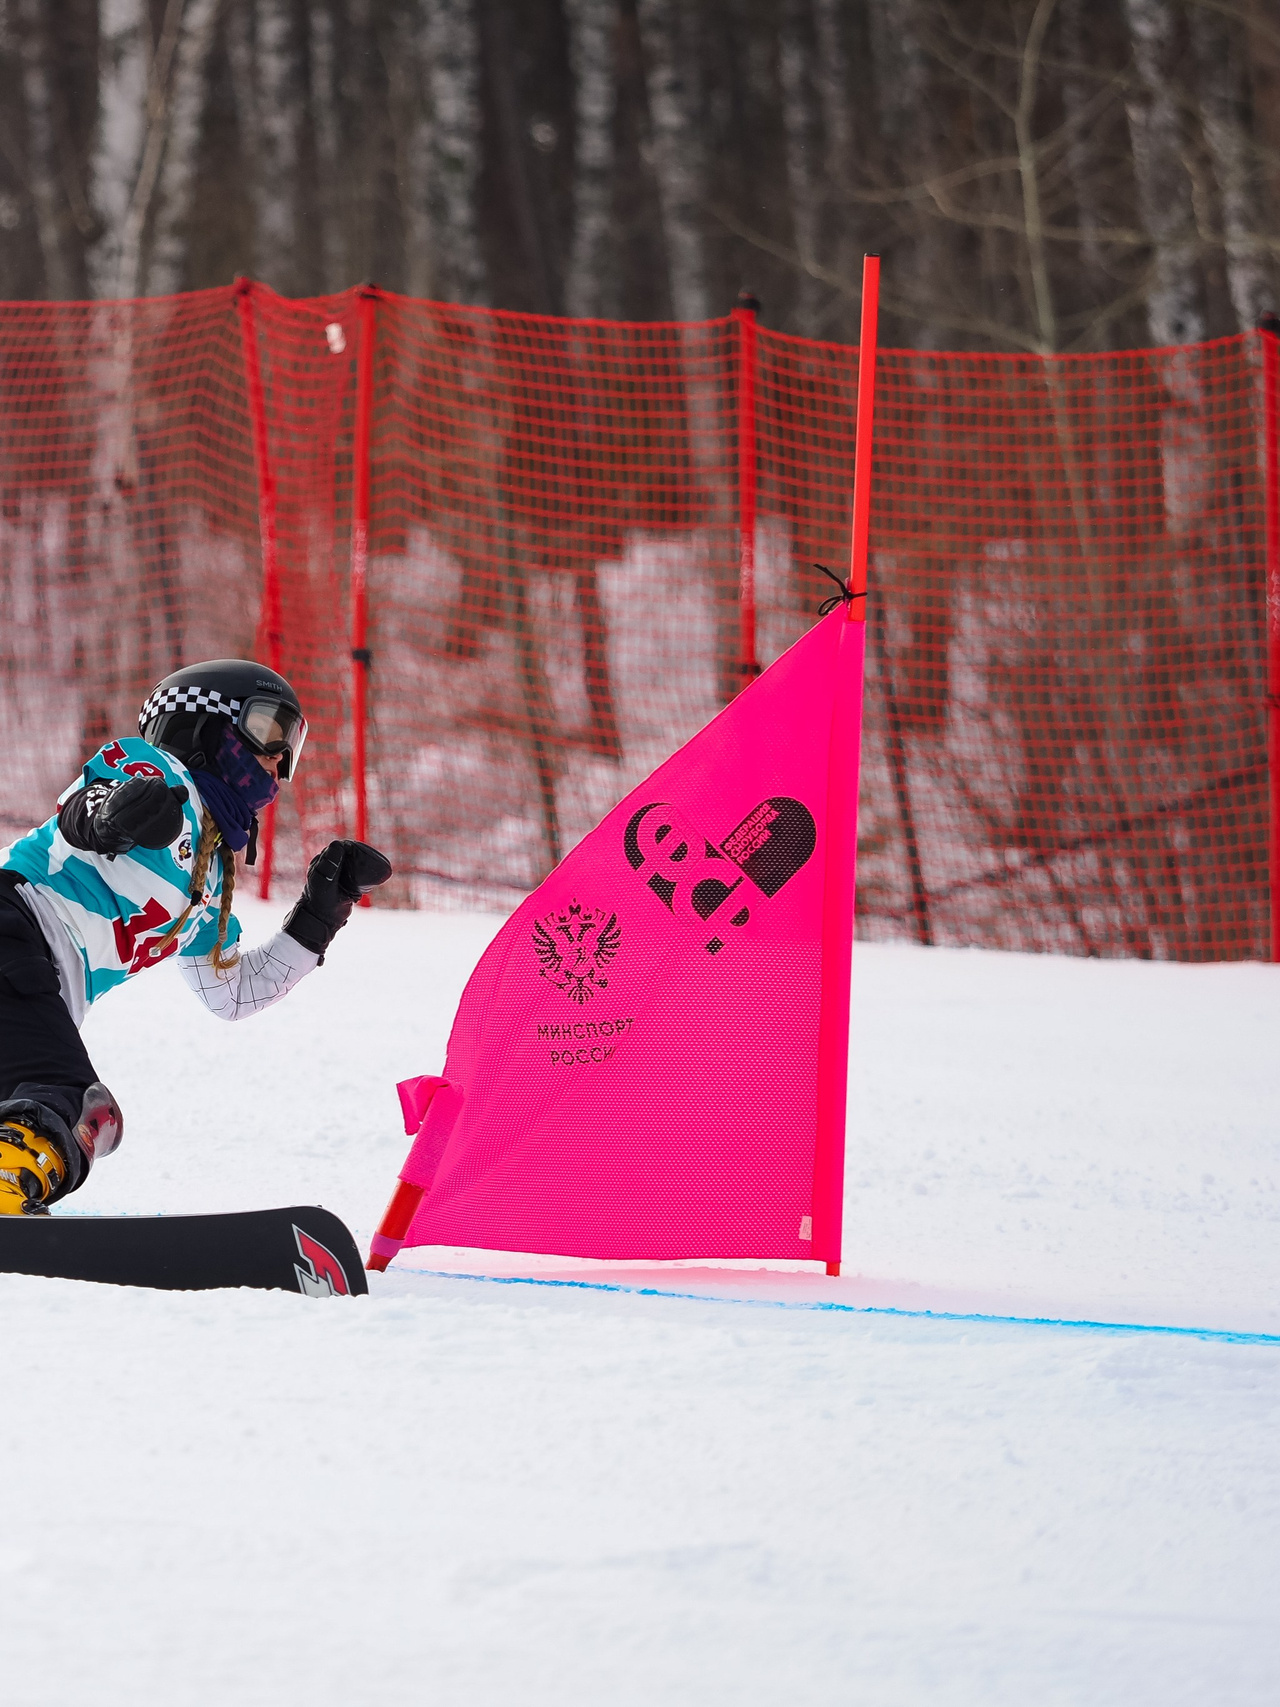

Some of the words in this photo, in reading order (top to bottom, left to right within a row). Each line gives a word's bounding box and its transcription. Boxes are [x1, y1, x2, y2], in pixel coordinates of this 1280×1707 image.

[255, 679, 283, 692] SMITH
[724, 802, 771, 851] ФЕДЕРАЦИЯ
[730, 809, 780, 857] СНОУБОРДА
[537, 1017, 635, 1040] МИНСПОРТ
[550, 1046, 619, 1067] РОССИ
